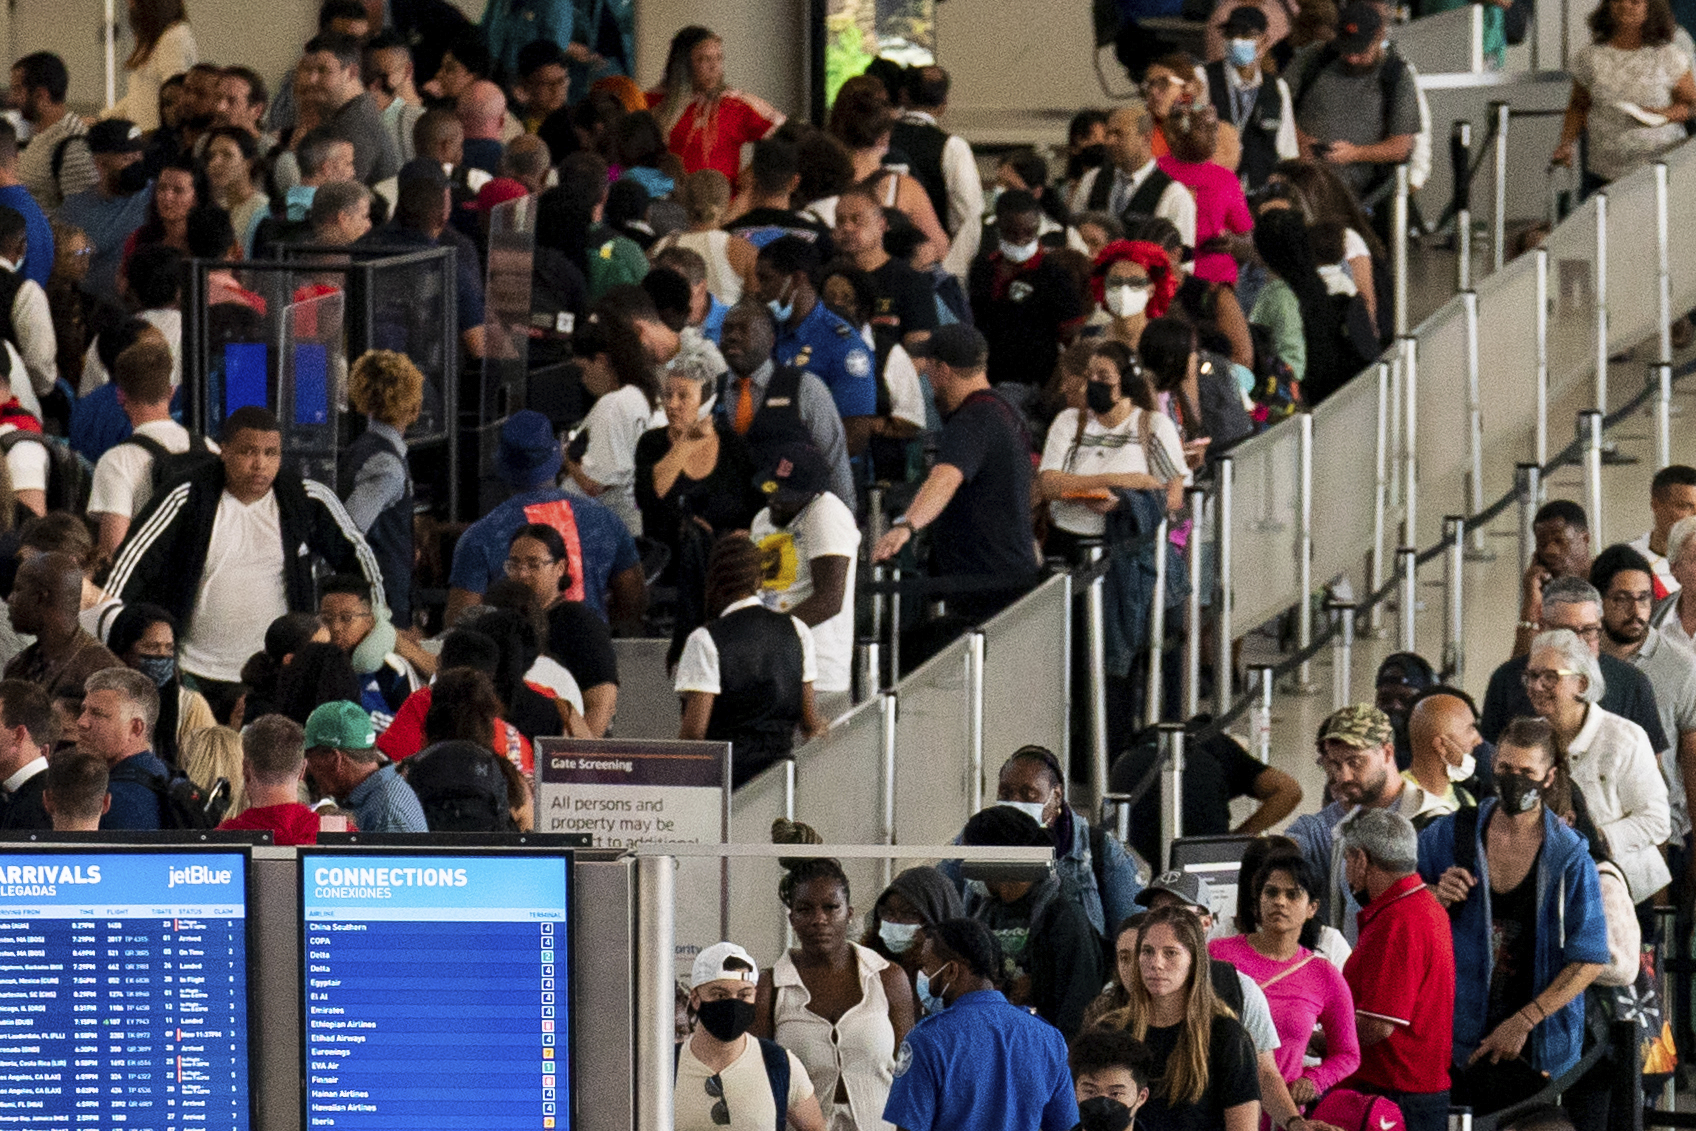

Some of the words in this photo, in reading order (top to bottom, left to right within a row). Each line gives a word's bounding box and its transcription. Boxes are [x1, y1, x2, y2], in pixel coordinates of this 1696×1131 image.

[551, 758, 576, 768] Gate
[578, 758, 632, 772] Screening
[551, 796, 570, 809] All
[575, 800, 631, 811] persons
[636, 799, 663, 812] and
[551, 818, 615, 832] property
[620, 820, 651, 833] may
[657, 818, 674, 832] be
[168, 866, 232, 888] jetBlue
[315, 868, 467, 887] CONNECTIONS
[315, 887, 391, 898] CONEXIONES
[311, 1006, 344, 1014] Emirates
[311, 1020, 346, 1029] Ethiopian
[336, 1035, 365, 1043] Airways
